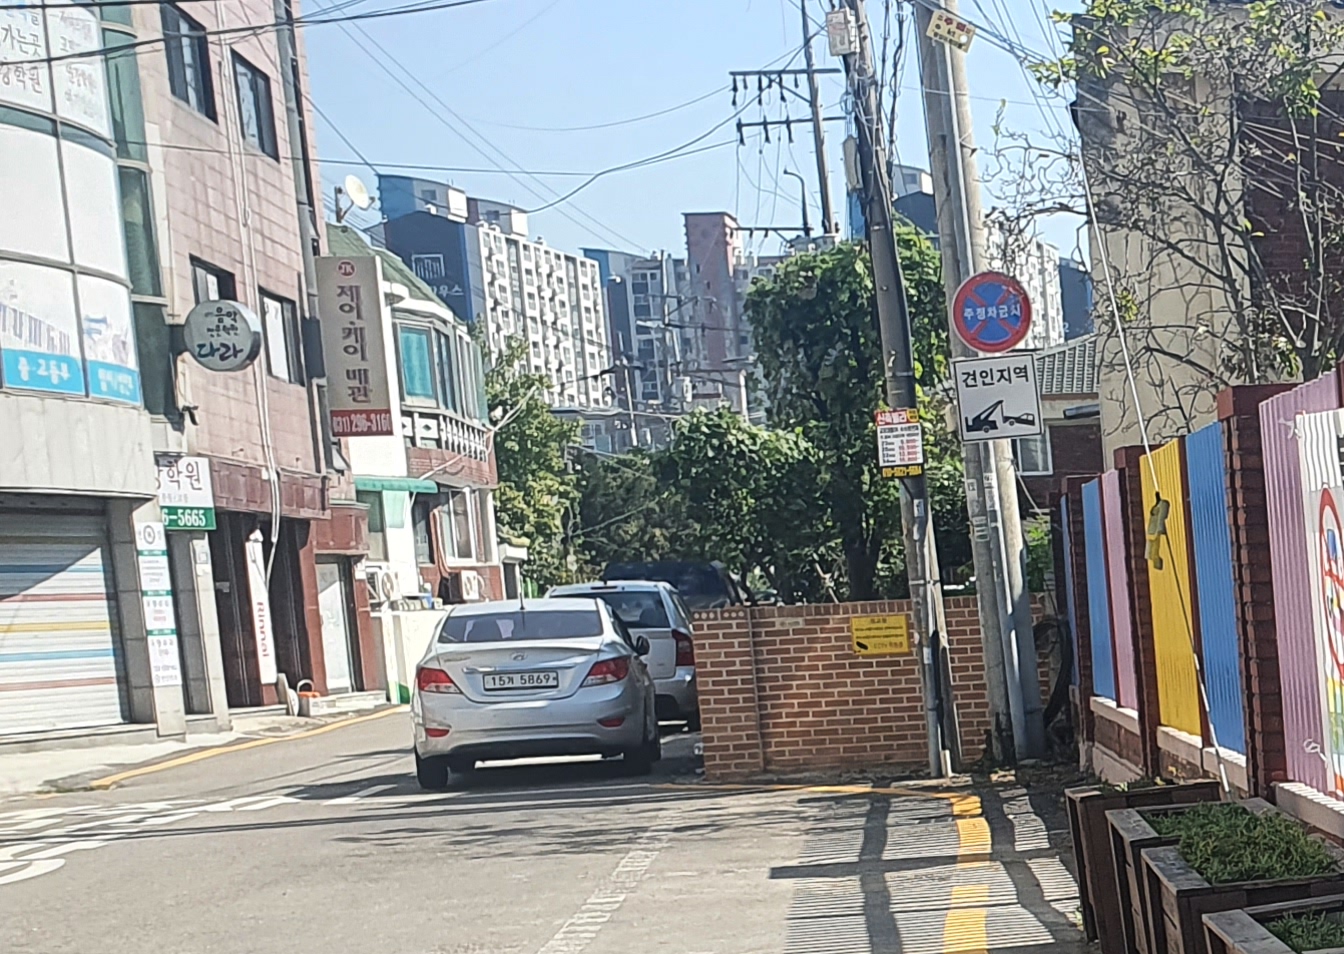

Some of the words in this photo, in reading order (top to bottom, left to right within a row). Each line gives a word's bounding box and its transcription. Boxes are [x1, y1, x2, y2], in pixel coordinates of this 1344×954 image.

[213, 306, 238, 324] 음악
[963, 304, 1021, 321] 주정차금지
[196, 341, 244, 361] 다라
[346, 368, 371, 403] 배관
[961, 365, 1030, 388] 견인지역
[257, 601, 269, 657] Rinnai
[520, 673, 550, 686] 5869
